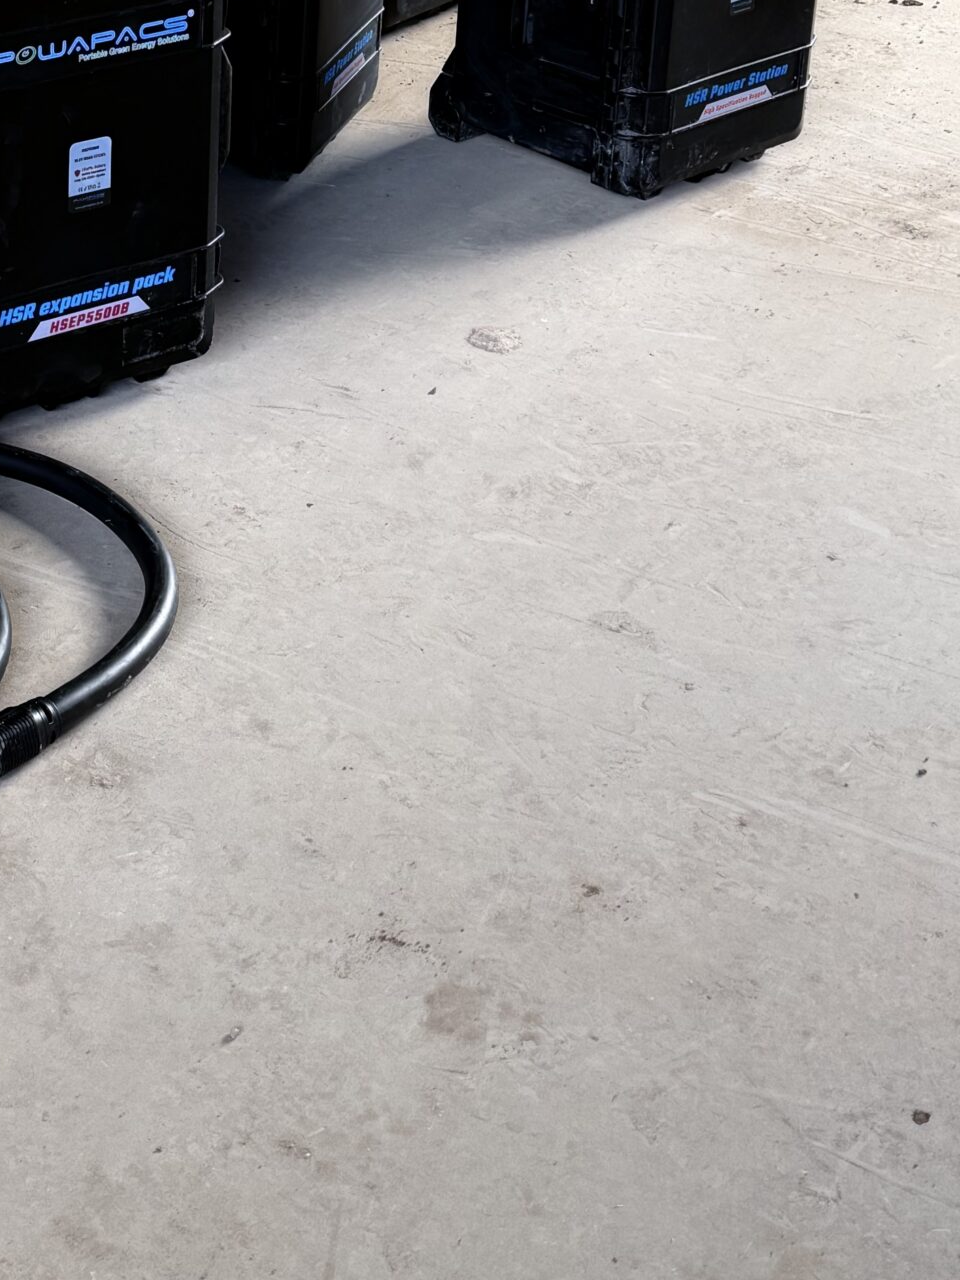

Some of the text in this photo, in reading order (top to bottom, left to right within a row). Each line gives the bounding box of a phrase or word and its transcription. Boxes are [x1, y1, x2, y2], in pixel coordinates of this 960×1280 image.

[79, 33, 190, 62] Portable Green Energy Solutions
[684, 63, 789, 108] HSR Power Station
[39, 281, 130, 313] expansion
[132, 266, 176, 294] pack
[50, 302, 130, 333] HSEP5500B
